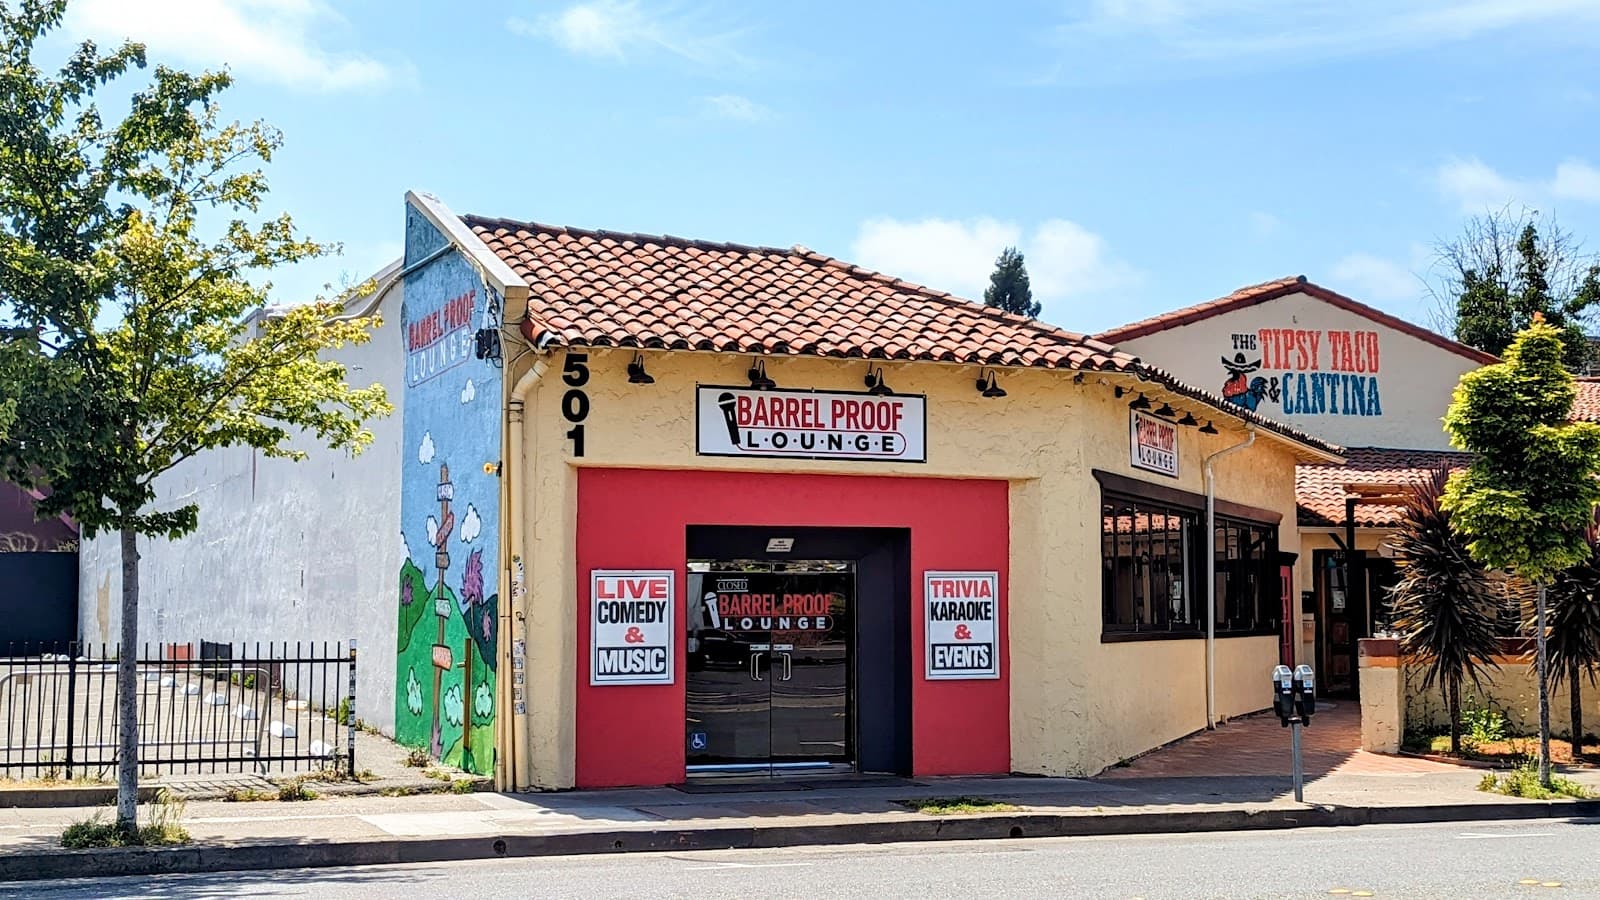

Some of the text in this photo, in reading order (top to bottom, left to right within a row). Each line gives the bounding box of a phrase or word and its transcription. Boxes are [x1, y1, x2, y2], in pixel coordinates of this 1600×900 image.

[408, 289, 476, 353] BARREL PROOF
[412, 328, 470, 382] LOUNGE
[1231, 328, 1379, 373] THE TIPSY TACO
[561, 353, 590, 457] 501
[1281, 372, 1382, 416] CANTINA
[737, 395, 904, 431] BARREL PROOF
[1139, 416, 1174, 451] BARREL PROOF
[597, 579, 667, 599] LIVE
[717, 581, 748, 591] CLOSED
[930, 580, 992, 598] TRIVIA
[597, 601, 667, 624] COMEDY
[719, 592, 833, 616] BARREL PROOF
[930, 601, 992, 621] KARAOKE
[625, 626, 645, 644] &
[954, 624, 972, 640] &
[598, 648, 666, 673] MUSIC
[934, 645, 989, 668] EVENTS
